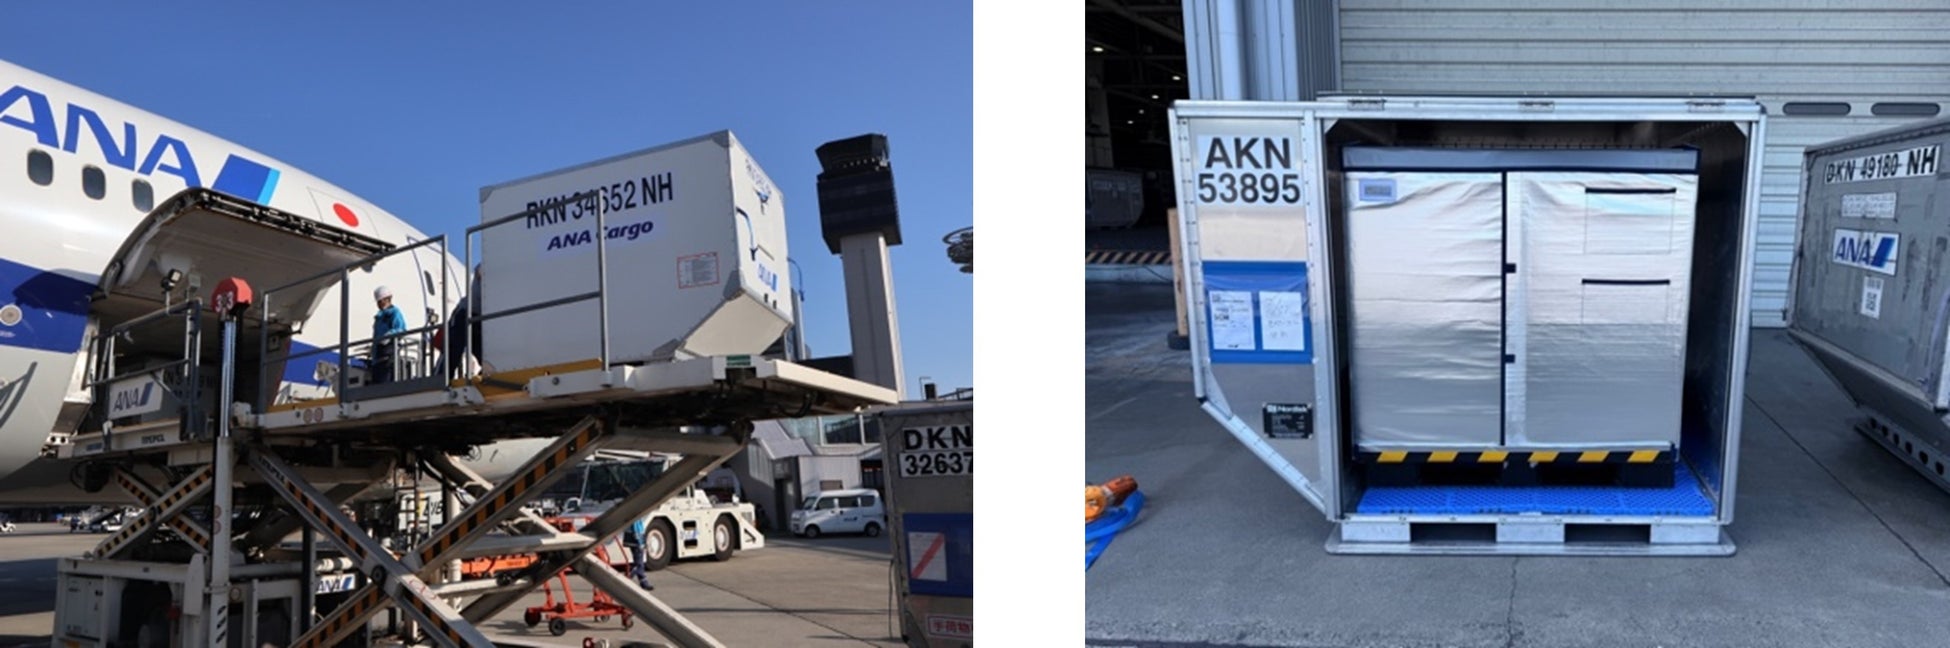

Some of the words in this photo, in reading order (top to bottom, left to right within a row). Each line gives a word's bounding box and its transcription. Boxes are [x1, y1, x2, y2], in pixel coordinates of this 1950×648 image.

[0, 85, 203, 188] ANA
[1205, 137, 1291, 169] AKN
[1826, 160, 1856, 182] DKN
[1860, 153, 1900, 178] 49180
[1906, 147, 1936, 176] NH
[526, 195, 566, 229] RKN
[641, 172, 673, 206] NH
[1198, 173, 1300, 203] 53895
[547, 230, 592, 250] ANA
[1835, 236, 1872, 266] ANA
[904, 425, 973, 450] DKN
